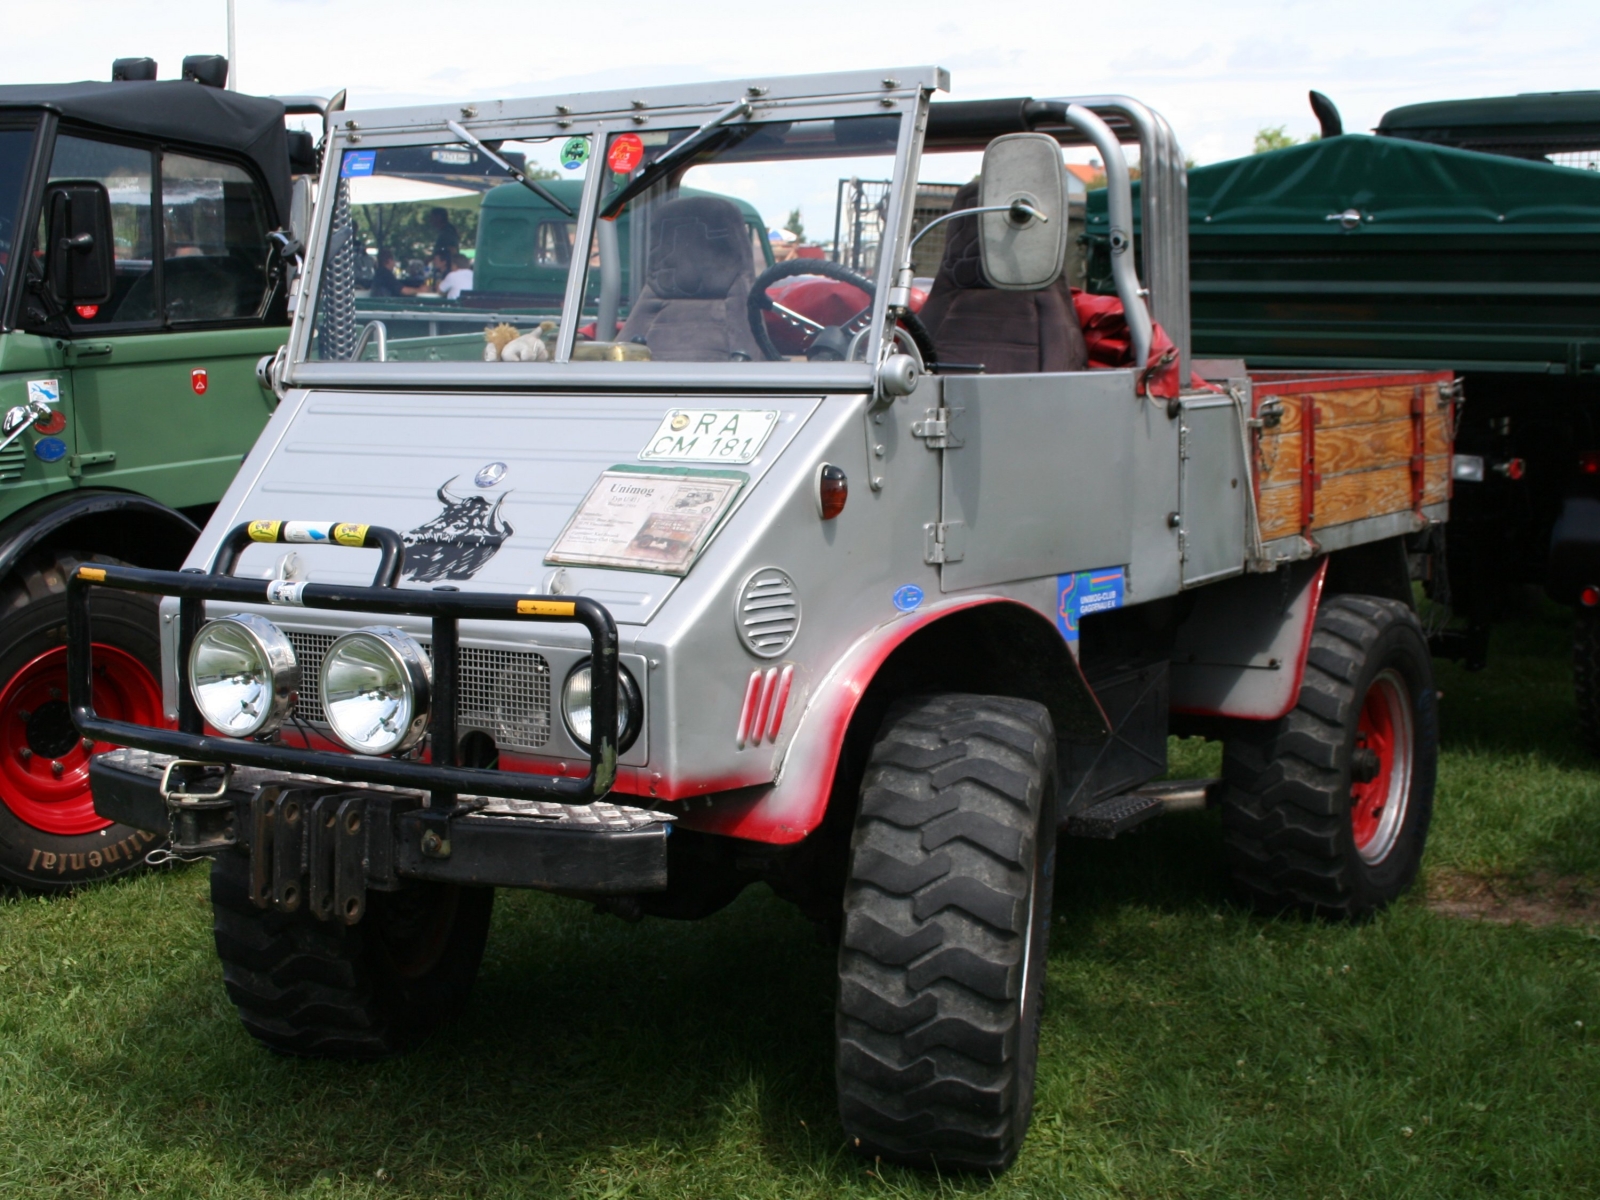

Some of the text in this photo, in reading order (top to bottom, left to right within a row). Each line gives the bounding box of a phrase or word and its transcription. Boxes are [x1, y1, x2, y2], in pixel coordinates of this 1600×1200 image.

[694, 413, 740, 435] RA
[652, 436, 754, 457] CM 181
[610, 483, 655, 497] Unimog
